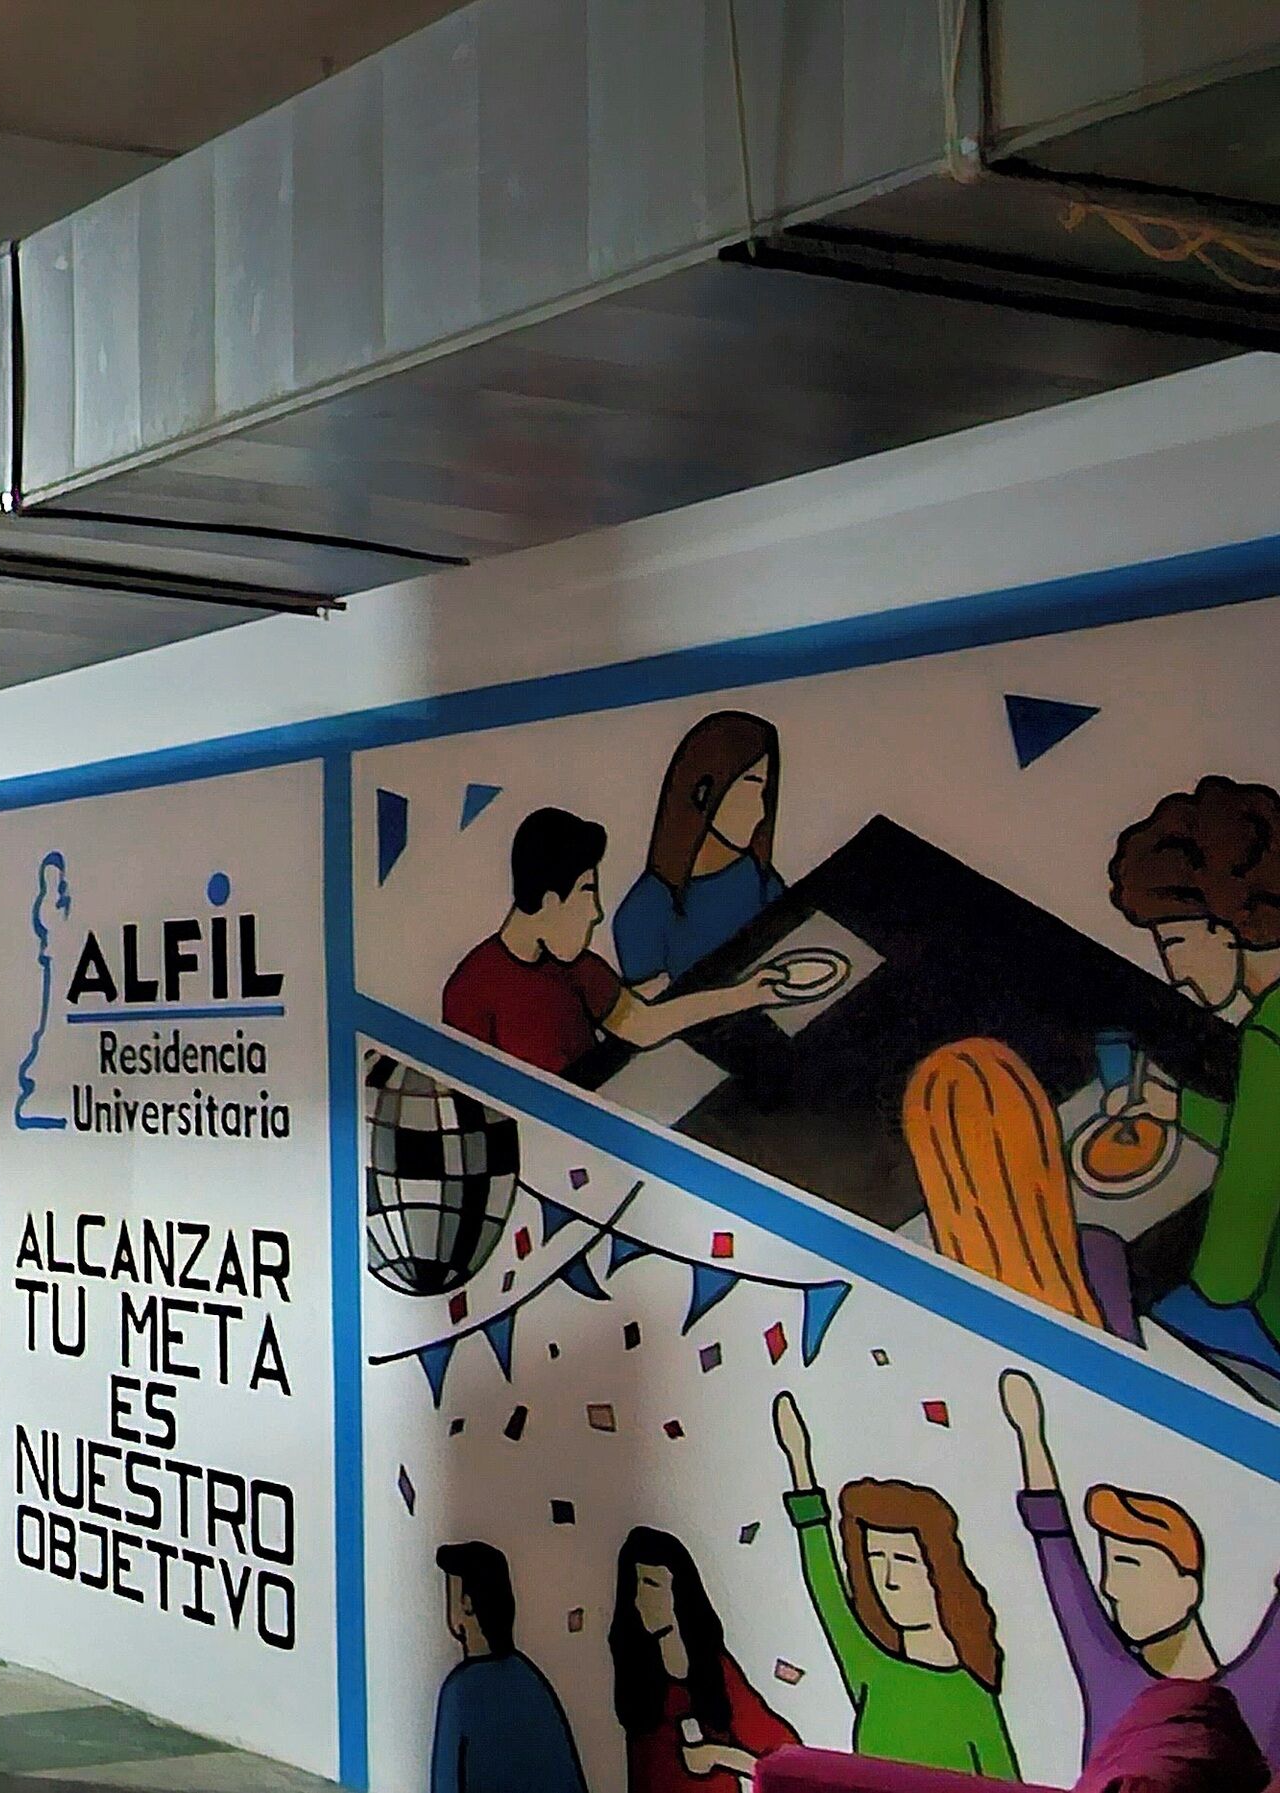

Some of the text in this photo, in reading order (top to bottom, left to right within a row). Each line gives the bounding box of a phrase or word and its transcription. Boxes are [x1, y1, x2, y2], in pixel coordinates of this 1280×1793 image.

[66, 872, 284, 1004] ALFIL
[100, 1029, 267, 1075] Residencia
[73, 1084, 290, 1139] Universitaria
[15, 1210, 291, 1303] ALCANZAR
[15, 1278, 292, 1396] TU META
[111, 1374, 177, 1450] ES
[16, 1424, 294, 1566] NUESTRO
[17, 1504, 295, 1651] OBJETIVO
